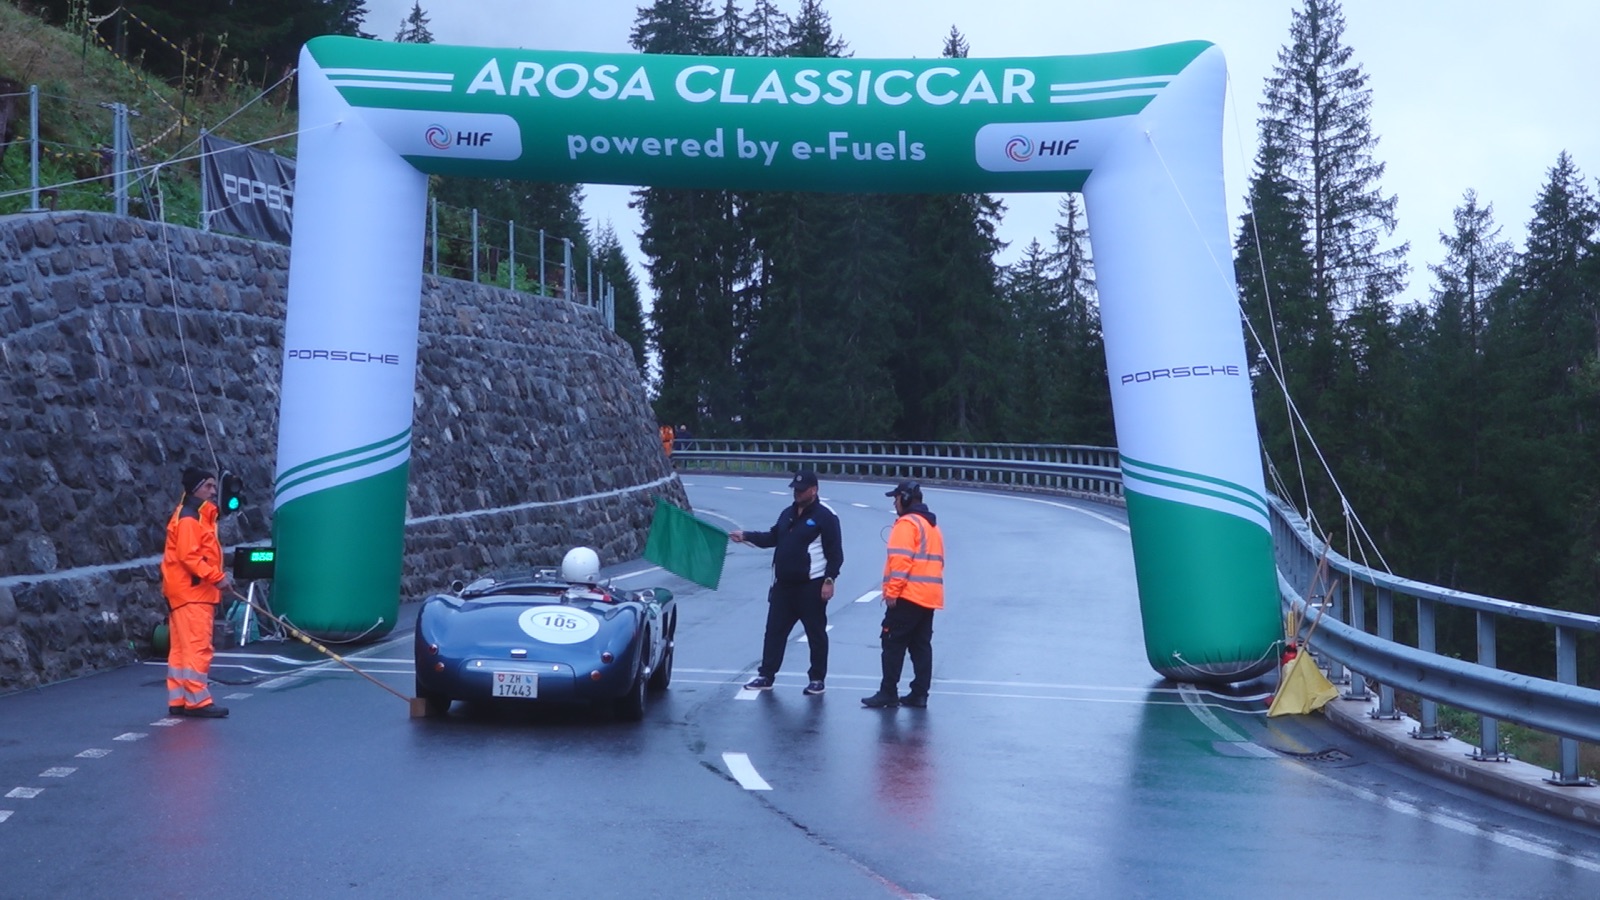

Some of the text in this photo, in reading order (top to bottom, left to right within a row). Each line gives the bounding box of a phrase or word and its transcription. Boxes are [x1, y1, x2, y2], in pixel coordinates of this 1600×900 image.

[465, 57, 1035, 105] AROSA CLASSICCAR
[456, 131, 493, 147] HIF
[567, 127, 926, 166] powered by e-Fuels
[1038, 139, 1080, 156] HIF
[223, 173, 294, 213] PORSC
[288, 349, 399, 365] PORSCHE
[1121, 365, 1240, 385] PORSCHE
[544, 616, 576, 629] 105
[510, 674, 521, 683] ZH
[499, 684, 531, 696] 17443
